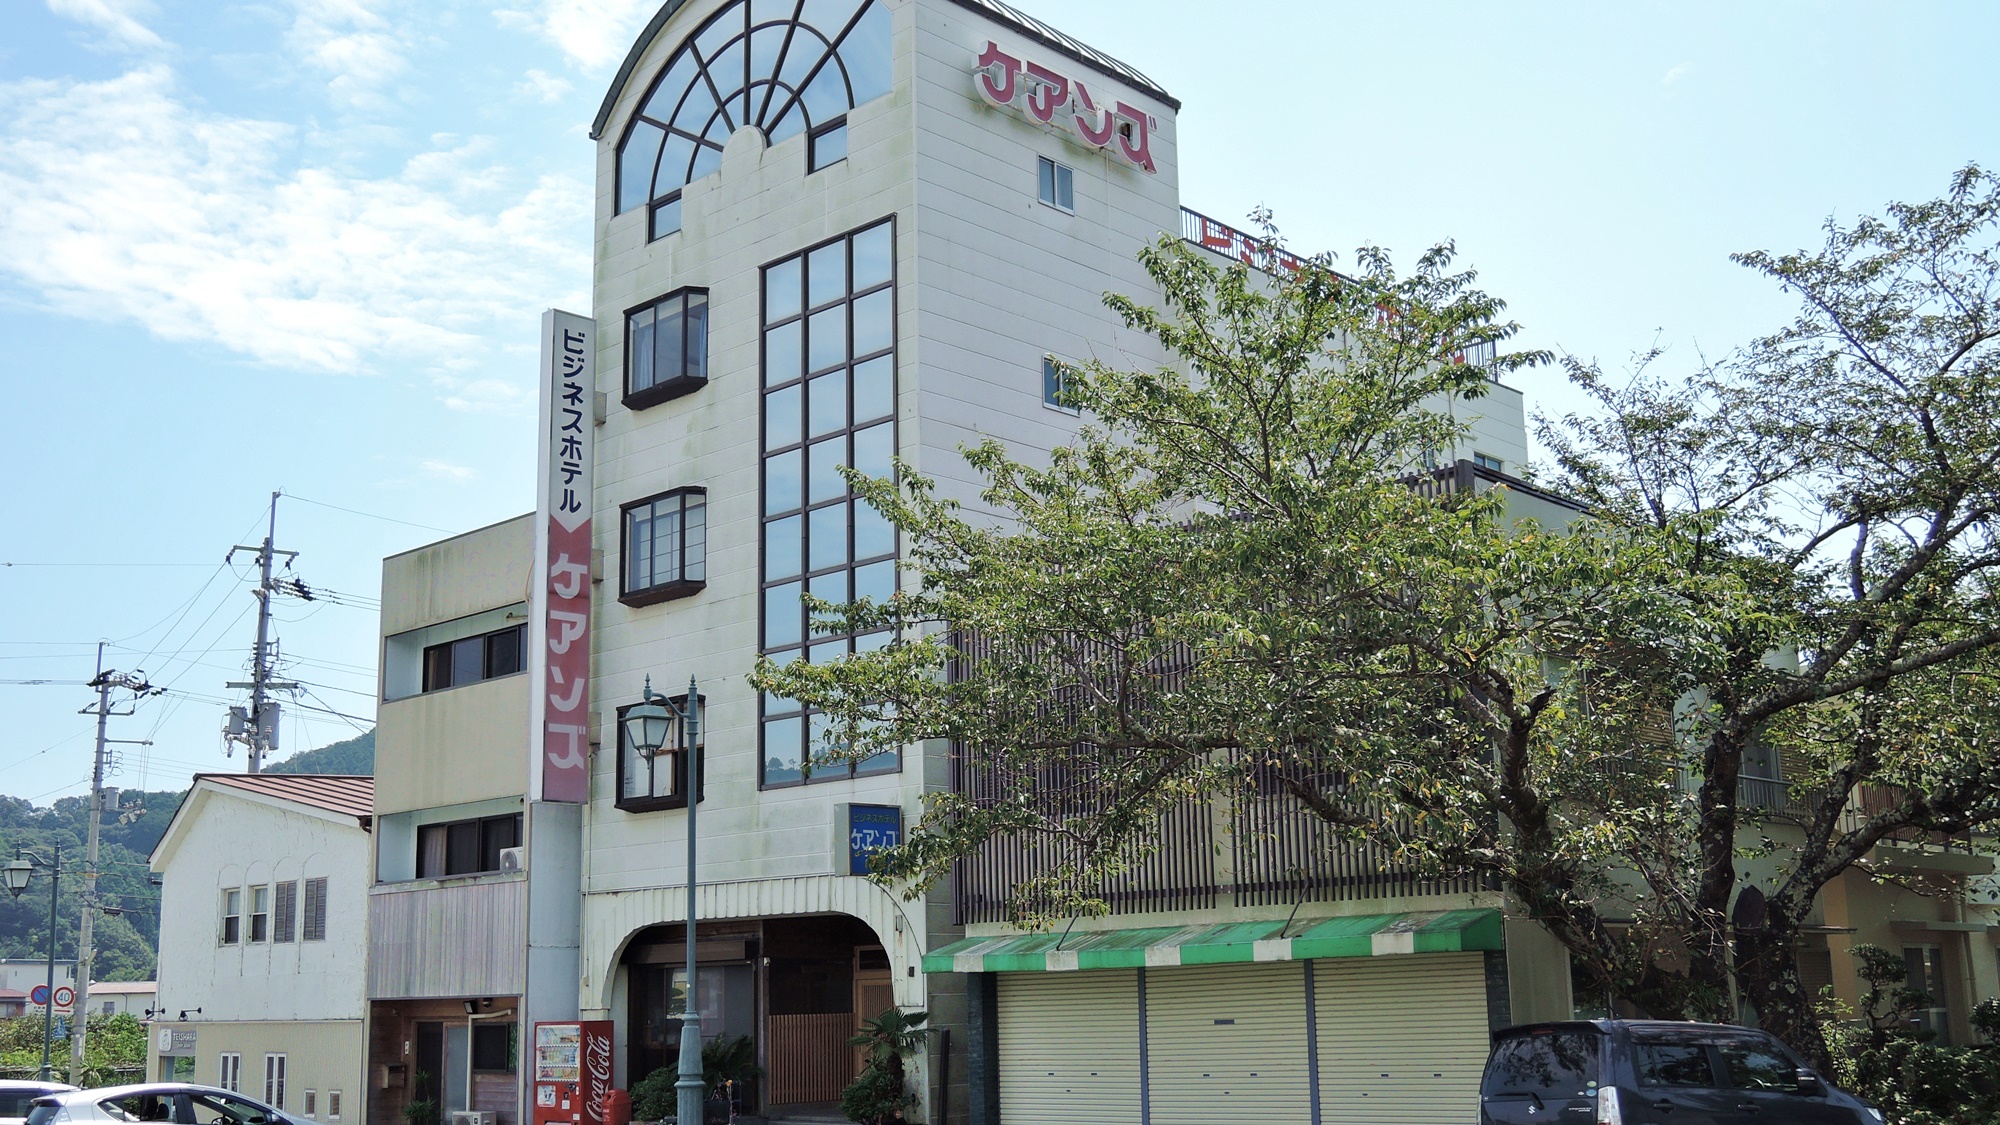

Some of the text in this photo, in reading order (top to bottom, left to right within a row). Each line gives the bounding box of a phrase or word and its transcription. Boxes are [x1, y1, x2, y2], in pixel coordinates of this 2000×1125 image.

[977, 40, 1157, 174] ケアンズ
[559, 328, 586, 514] ビジネスホテル
[548, 553, 588, 770] ケアンズ
[853, 813, 897, 824] ビジネスホテル
[57, 992, 70, 1002] 40
[586, 1031, 610, 1122] Coca-Cola
